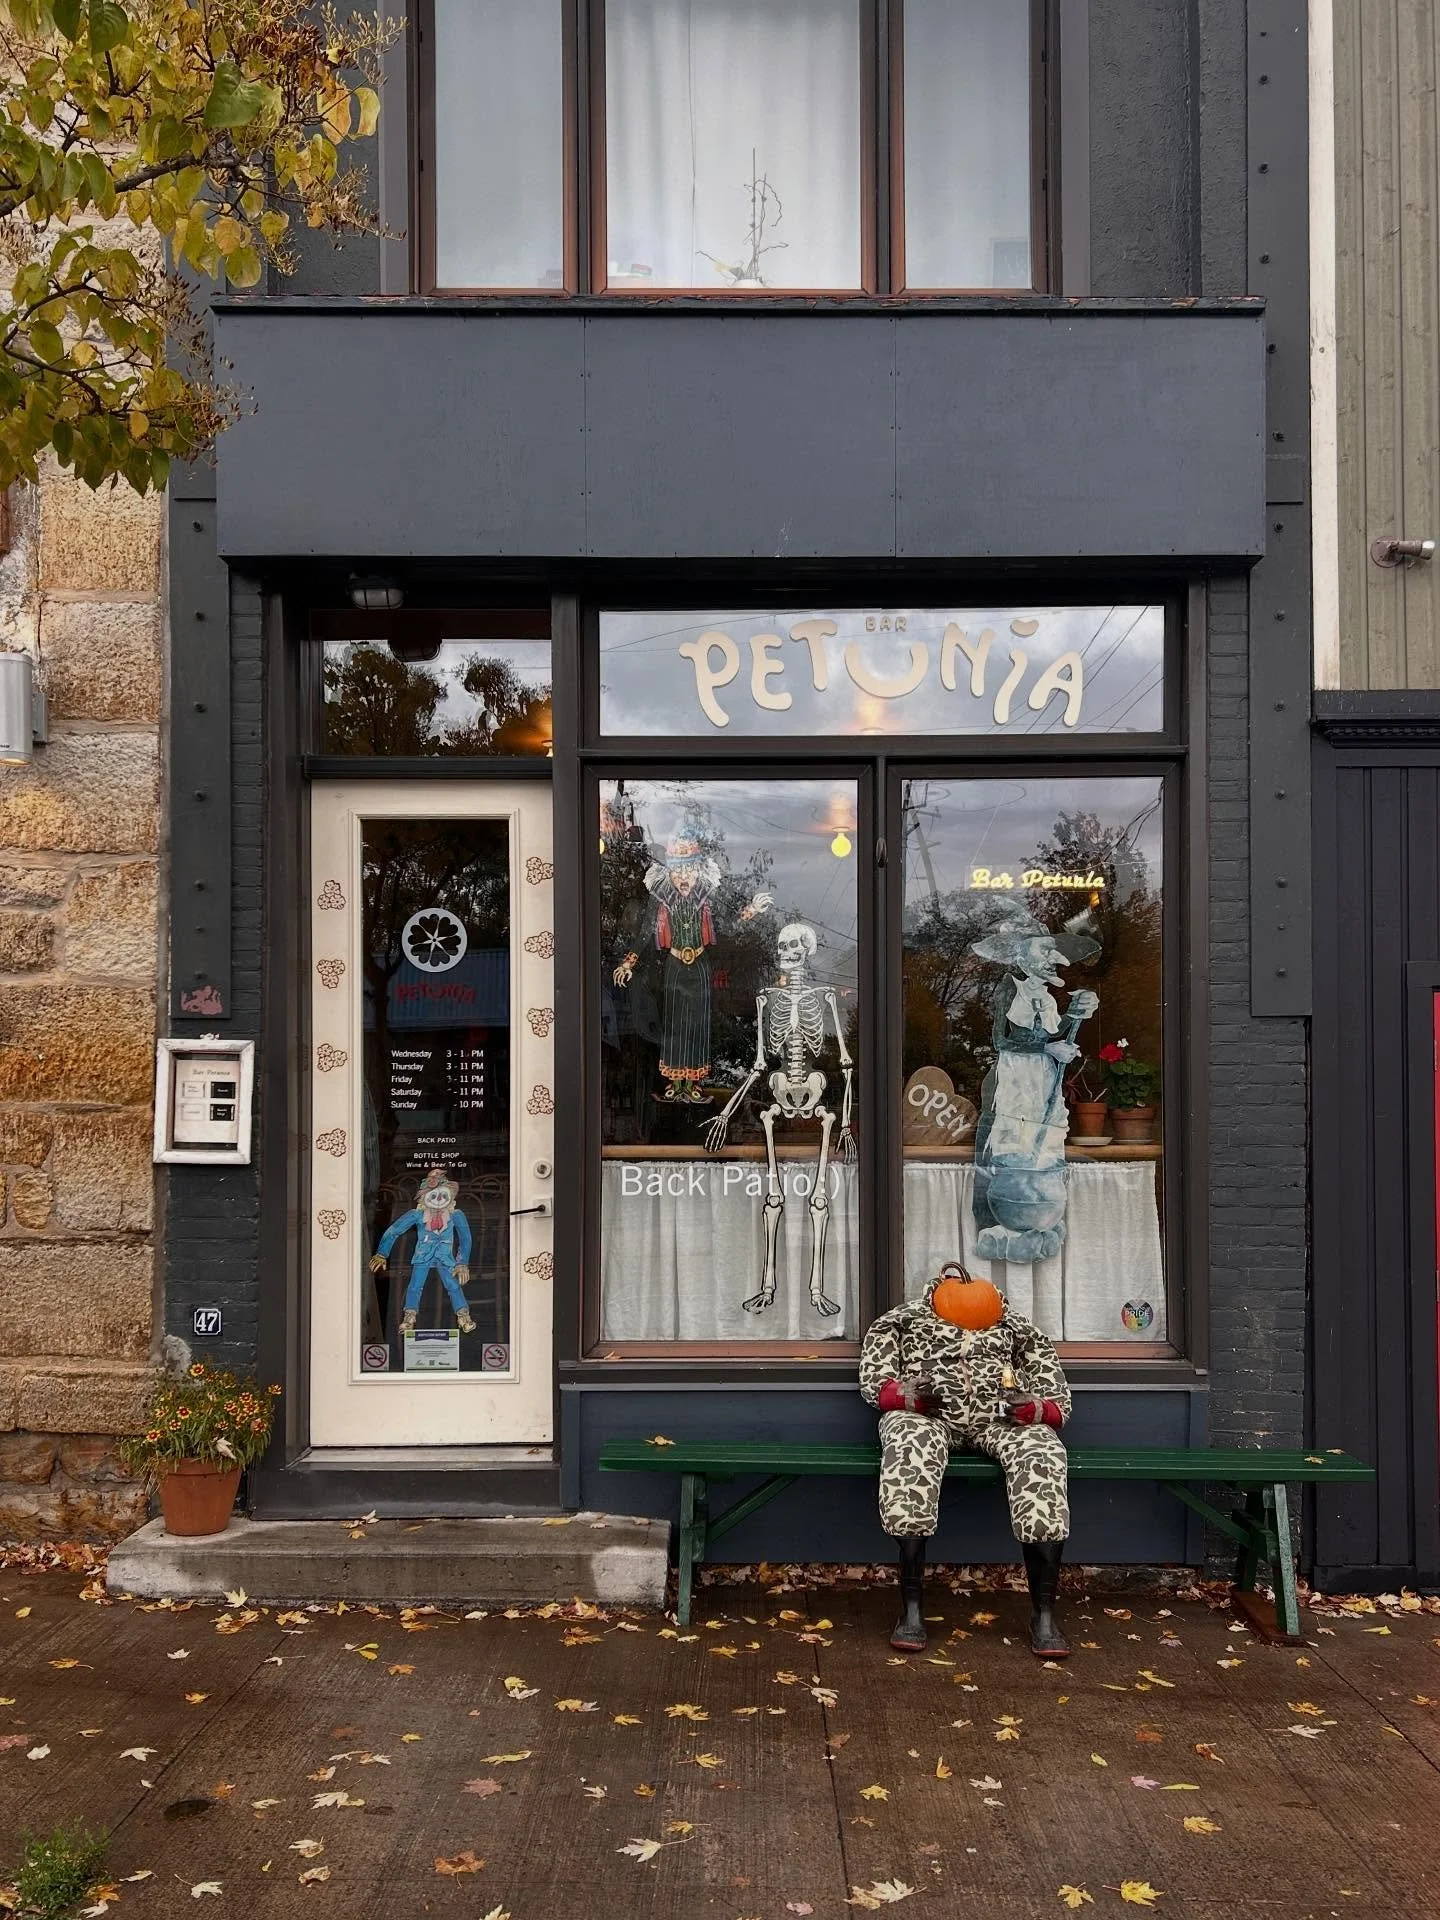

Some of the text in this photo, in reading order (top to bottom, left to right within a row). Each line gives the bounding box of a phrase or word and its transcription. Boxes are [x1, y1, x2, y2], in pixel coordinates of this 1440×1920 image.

[865, 616, 907, 633] BAR
[970, 868, 1106, 889] Bar Petunia
[391, 1049, 432, 1059] Wednesday
[446, 1049, 452, 1058] 3
[471, 1049, 484, 1058] PM
[391, 1062, 424, 1072] Thursday
[446, 1062, 452, 1070] 3
[460, 1062, 468, 1070] 11
[471, 1062, 484, 1070] PM
[391, 1075, 413, 1085] Friday
[460, 1075, 469, 1083] 11
[471, 1075, 484, 1083] PM
[391, 1088, 422, 1098] Saturday
[460, 1088, 468, 1096] 11
[471, 1088, 484, 1096] PM
[391, 1101, 417, 1110] Sunday
[460, 1100, 469, 1108] 10
[471, 1100, 484, 1108] PM
[907, 1084, 971, 1137] OPEN
[621, 1166, 706, 1197] Back
[723, 1166, 811, 1197] Patio
[196, 1312, 218, 1332] 47
